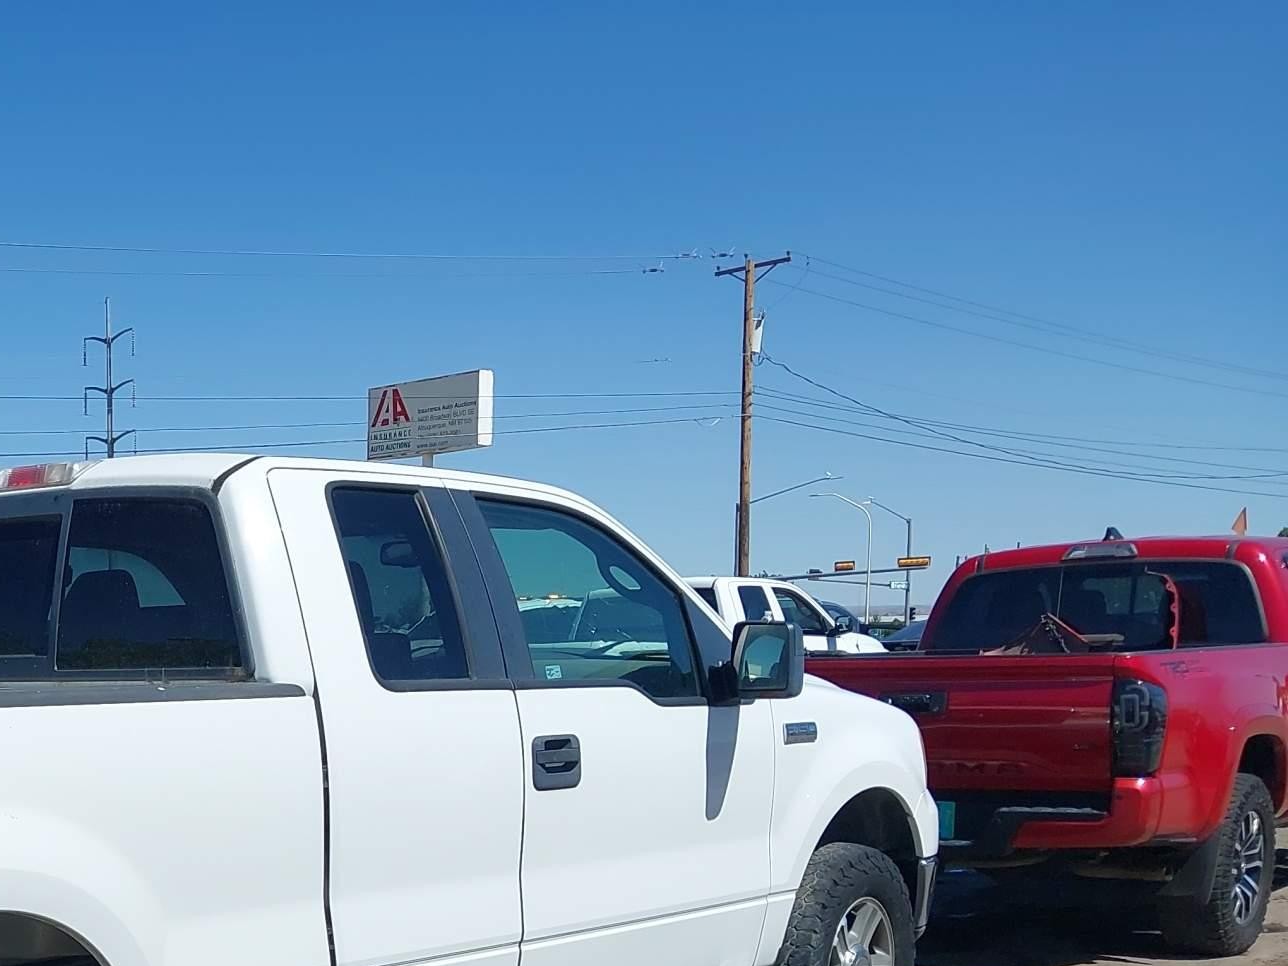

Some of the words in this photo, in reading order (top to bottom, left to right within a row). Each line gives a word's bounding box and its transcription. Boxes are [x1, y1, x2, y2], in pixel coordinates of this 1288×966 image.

[370, 429, 411, 440] INSURANCE
[370, 443, 385, 452] AUTO
[386, 440, 411, 450] AUCTIONS
